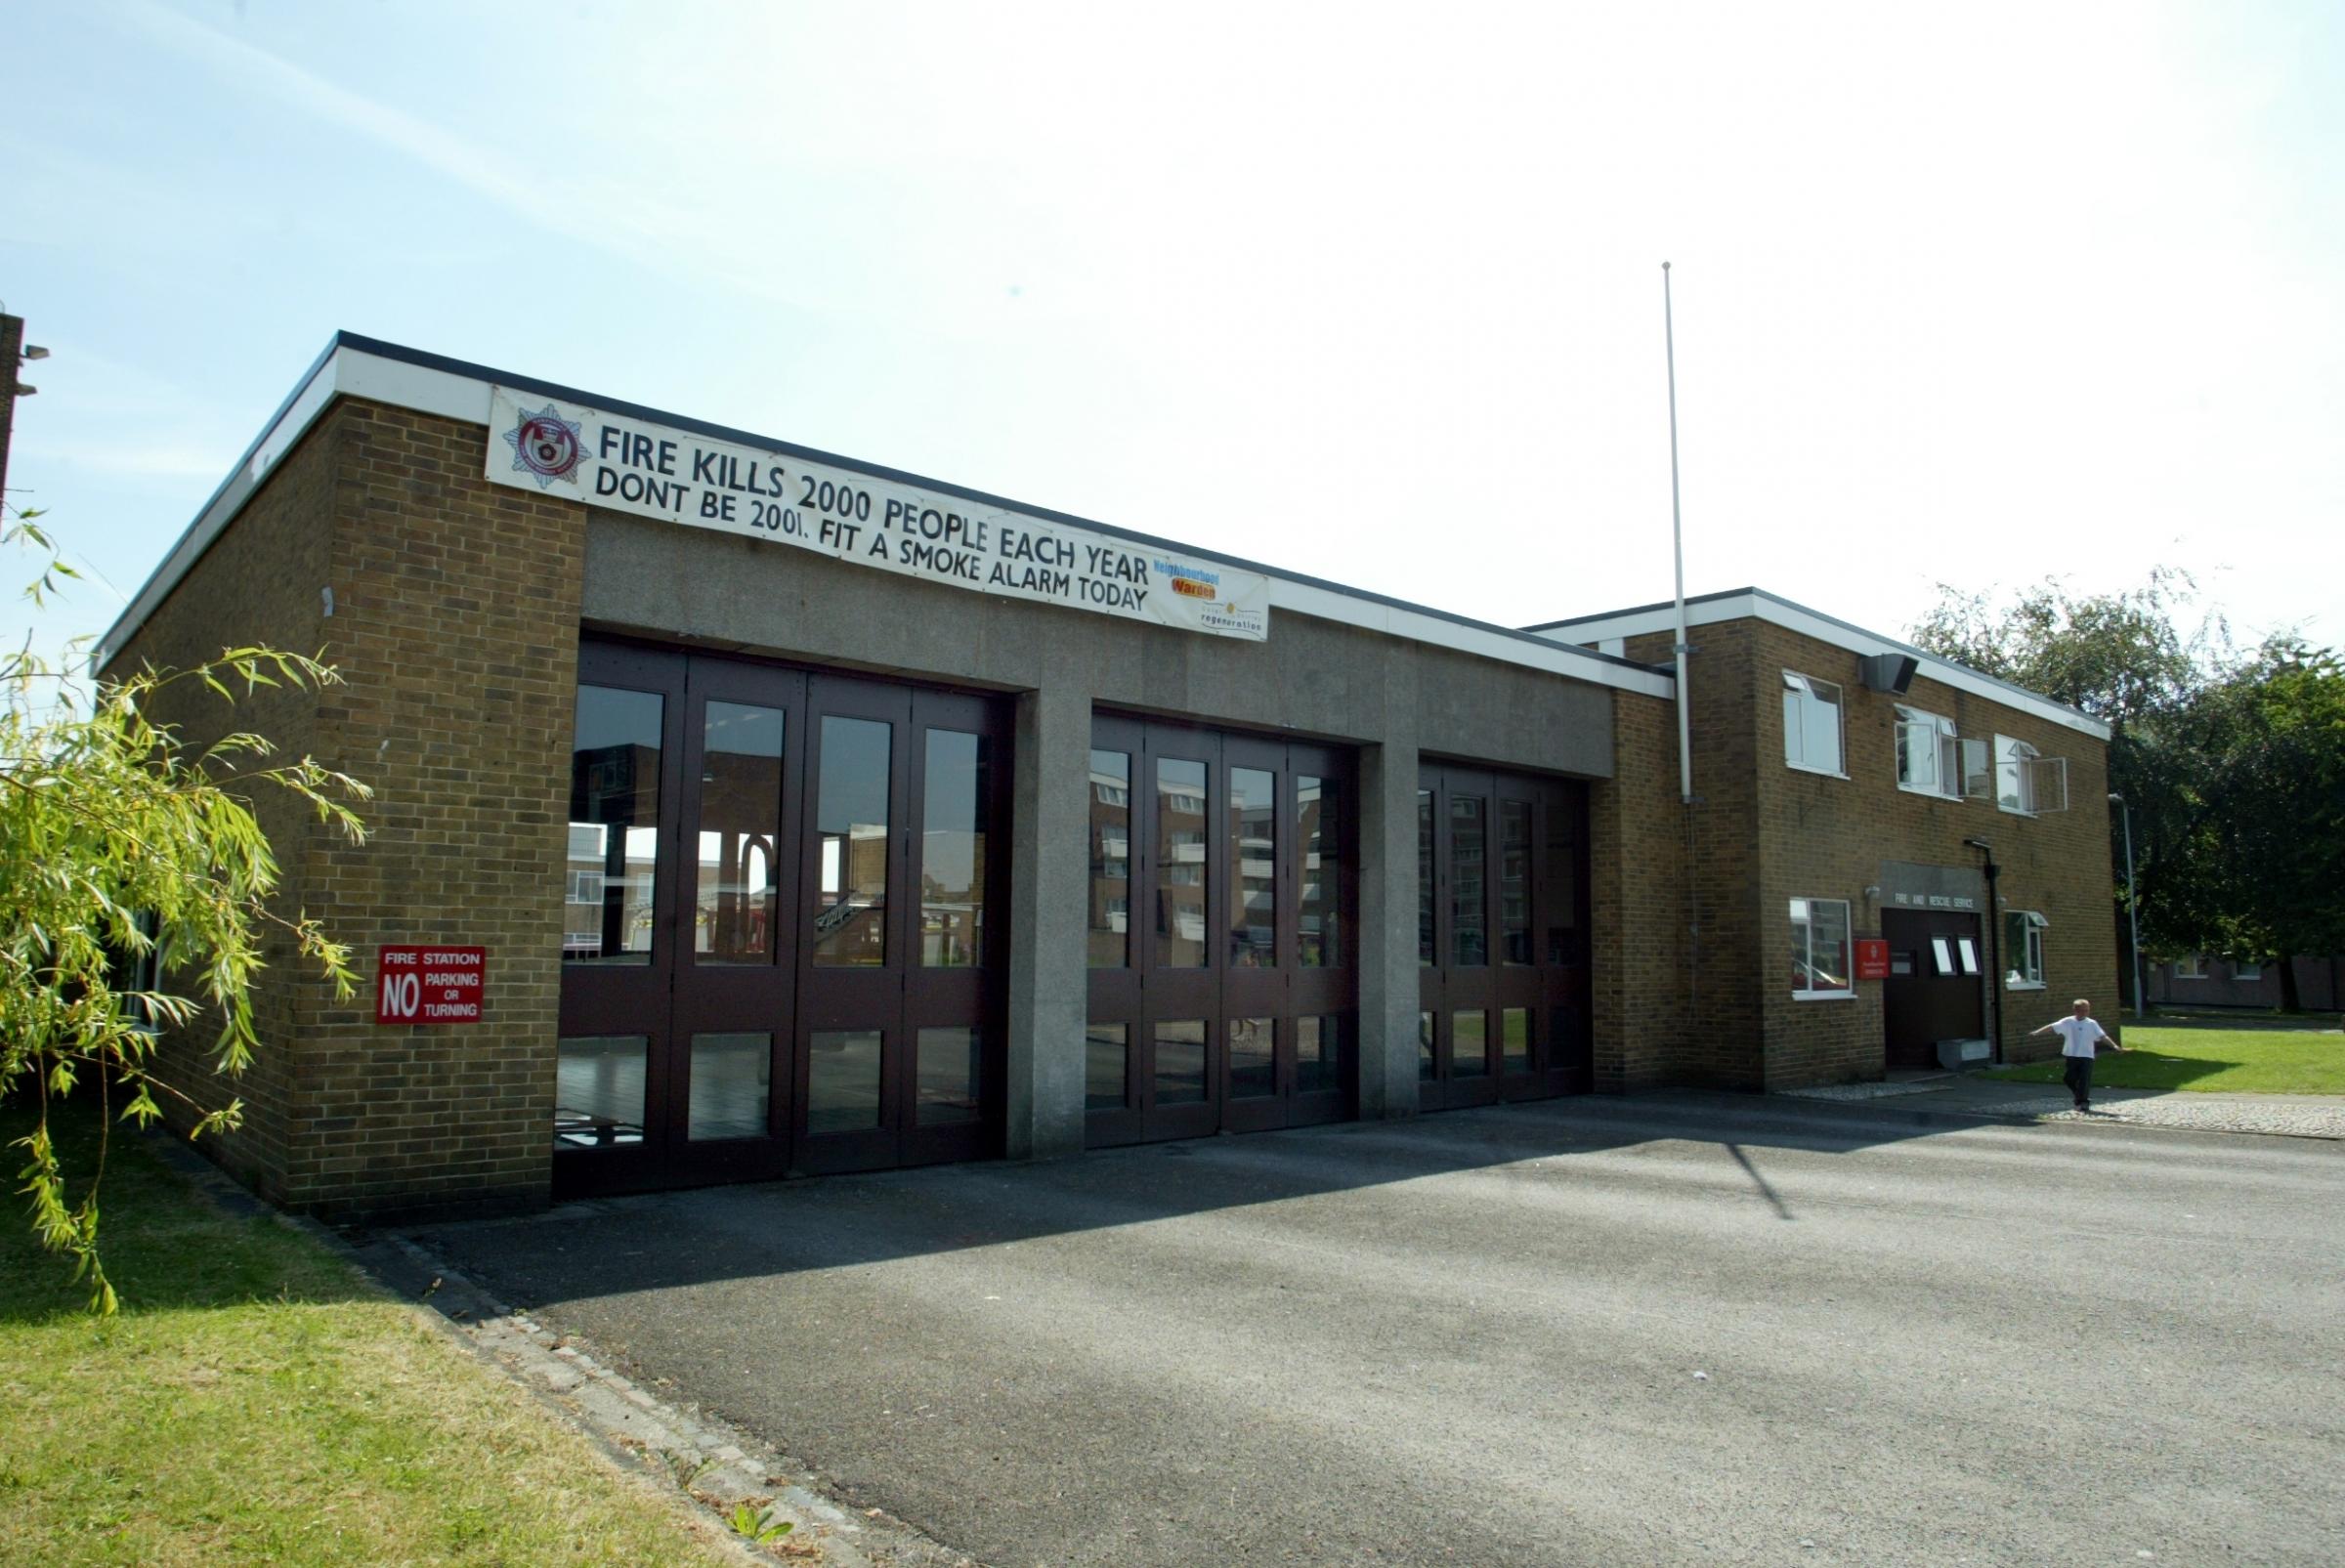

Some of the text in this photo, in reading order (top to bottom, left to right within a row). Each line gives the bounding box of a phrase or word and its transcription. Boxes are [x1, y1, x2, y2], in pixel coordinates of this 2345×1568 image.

[600, 425, 677, 476] FIRE
[693, 449, 785, 497] KILLS
[798, 475, 871, 522] 2000
[884, 498, 988, 553] PEOPLE
[1000, 529, 1075, 569] EACH
[1086, 545, 1149, 585] YEAR
[595, 467, 690, 512] DONT
[700, 491, 737, 522] BE
[819, 519, 861, 551] FIT
[868, 533, 888, 559] A
[899, 538, 980, 581] SMOKE
[989, 562, 1070, 597] ALARM
[1078, 579, 1148, 613] TODAY
[1201, 614, 1261, 631] regeneration
[385, 953, 480, 964] FIRE STATION
[425, 973, 479, 986] PARKING
[382, 972, 419, 1017] NO
[444, 990, 459, 1000] OR
[424, 1003, 477, 1016] TURNING
